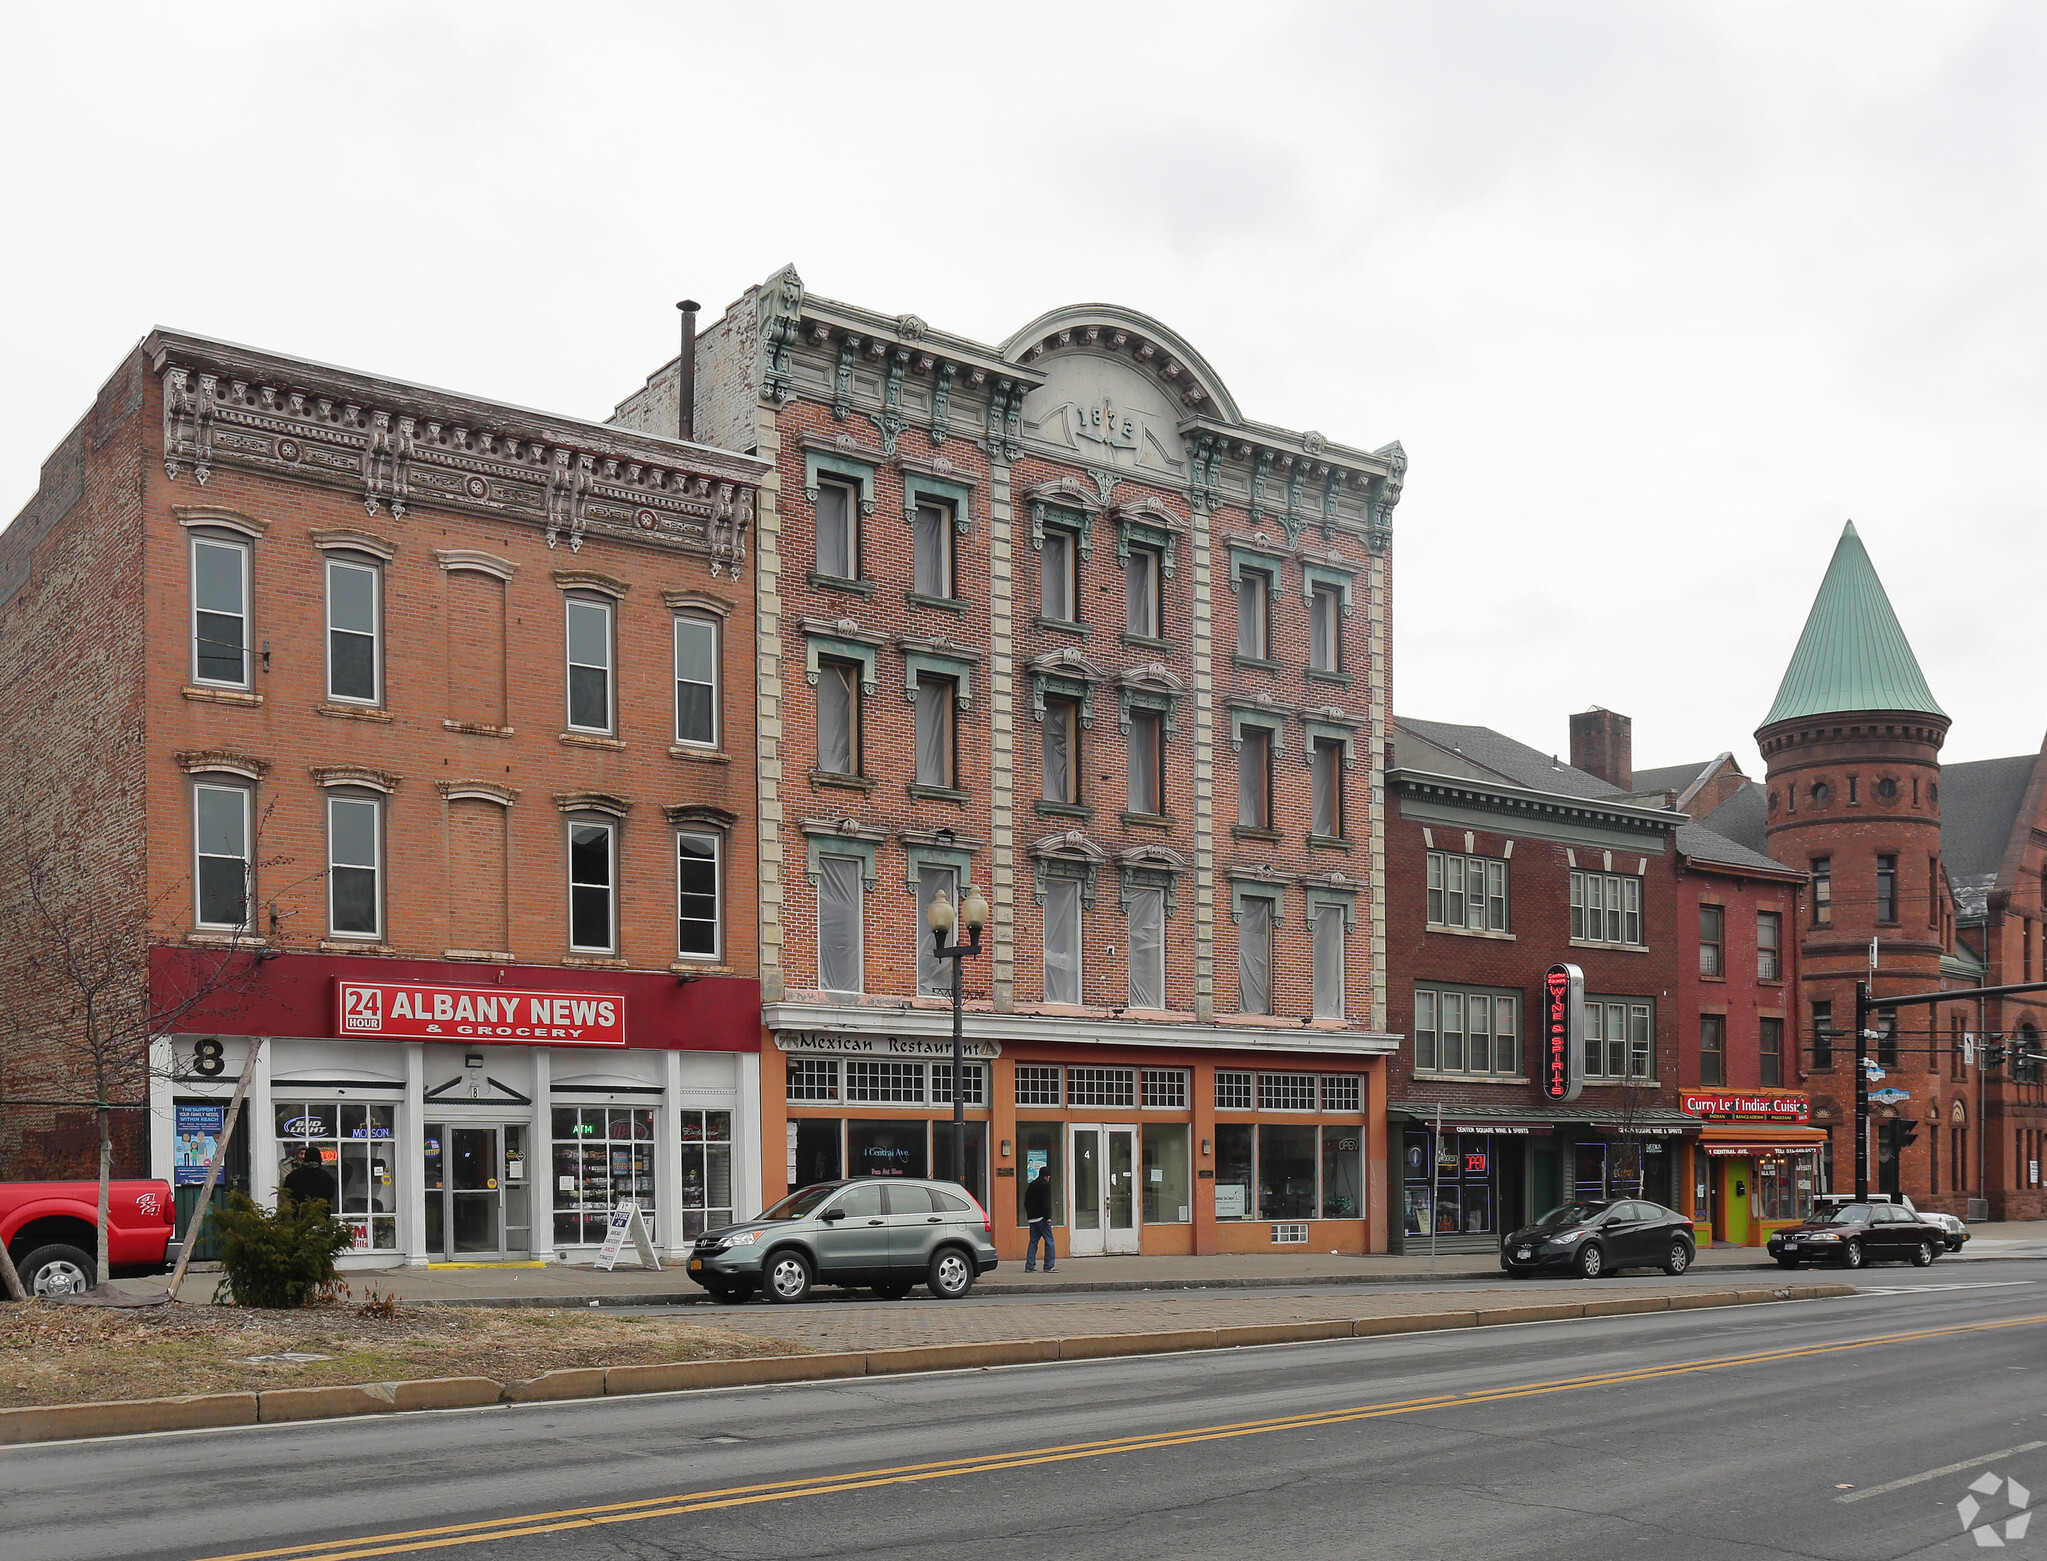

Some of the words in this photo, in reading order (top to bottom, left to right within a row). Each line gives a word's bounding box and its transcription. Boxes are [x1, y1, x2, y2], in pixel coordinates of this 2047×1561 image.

[347, 990, 380, 1016] 24
[390, 992, 521, 1024] ALBANY
[530, 998, 616, 1028] NEWS
[1549, 985, 1567, 1020] WINE
[349, 1017, 379, 1029] HOUR
[1551, 1025, 1565, 1034] &
[425, 1024, 443, 1034] &
[456, 1025, 584, 1038] GROCERY
[799, 1032, 873, 1051] Mexican
[887, 1037, 980, 1056] Restaurnt
[193, 1039, 225, 1076] 8
[1551, 1037, 1565, 1095] SPIRITS
[473, 1087, 478, 1098] 8
[1687, 1097, 1716, 1114] Curry
[1719, 1098, 1739, 1111] Lef
[352, 1128, 390, 1138] MOSON
[572, 1124, 594, 1134] ATM
[1084, 1150, 1091, 1160] 4
